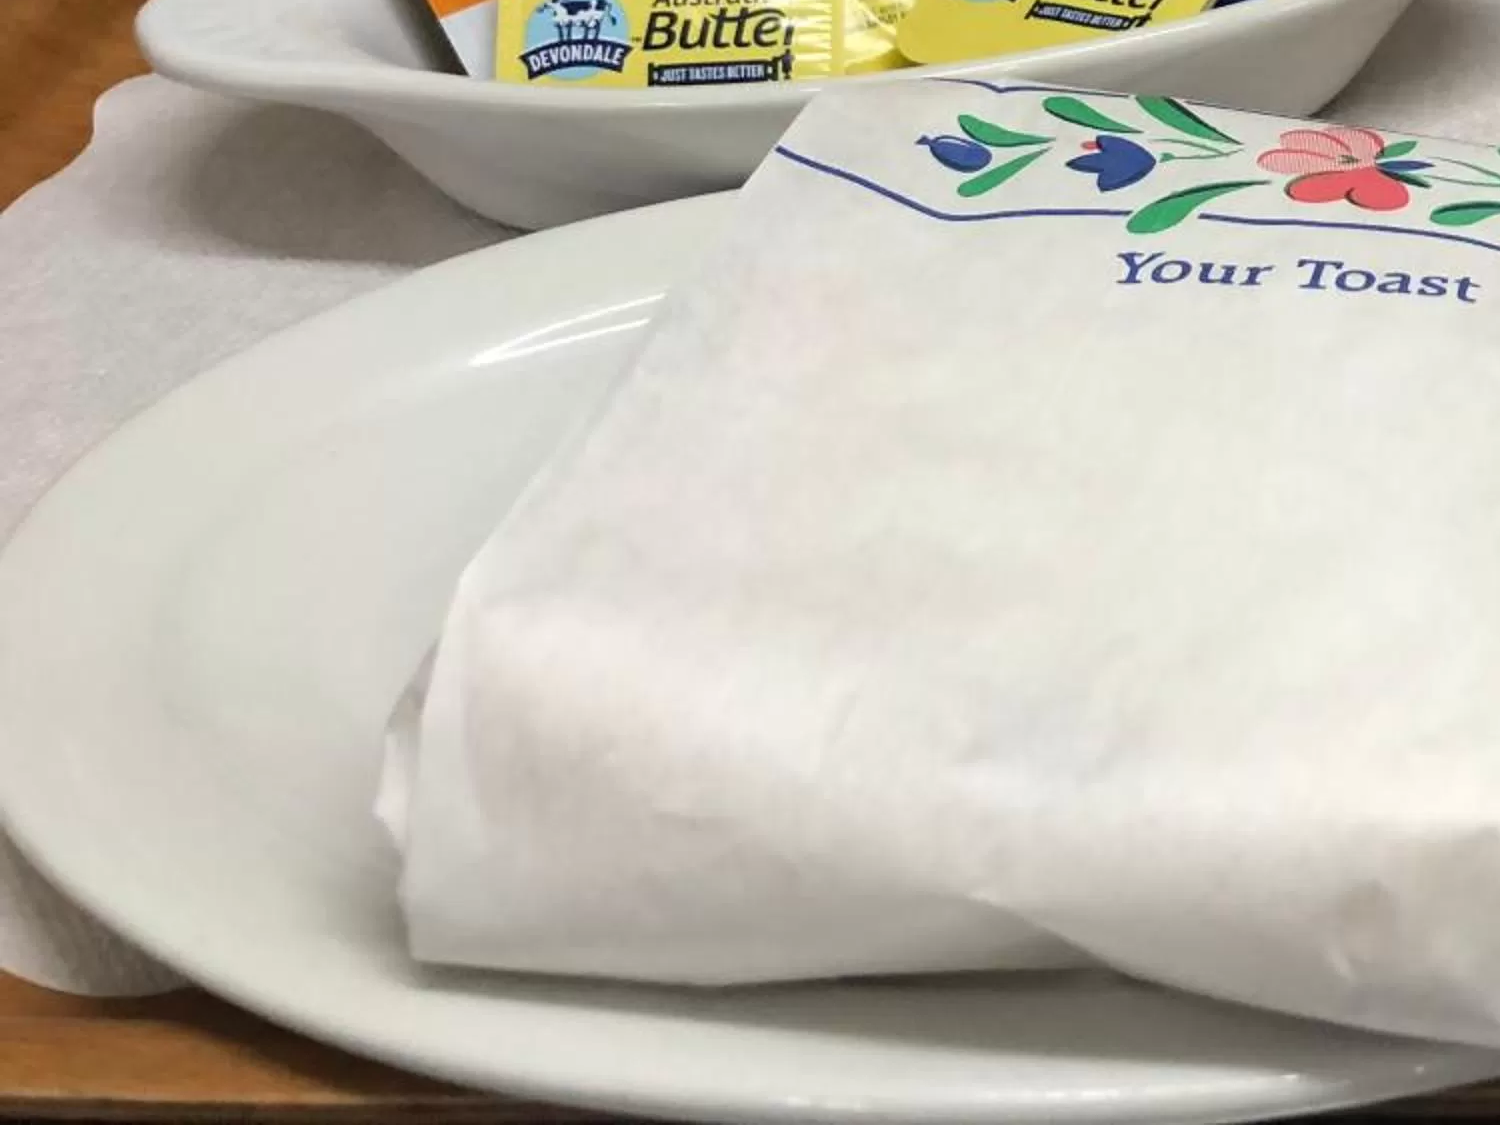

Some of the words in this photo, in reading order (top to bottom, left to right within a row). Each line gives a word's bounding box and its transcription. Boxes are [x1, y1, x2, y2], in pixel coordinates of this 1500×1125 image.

[642, 6, 796, 52] Butter
[527, 43, 626, 72] DEVONDALE
[660, 67, 687, 83] JUST
[727, 64, 766, 80] BETTER
[1115, 250, 1275, 287] Your
[1297, 258, 1484, 304] Toast
